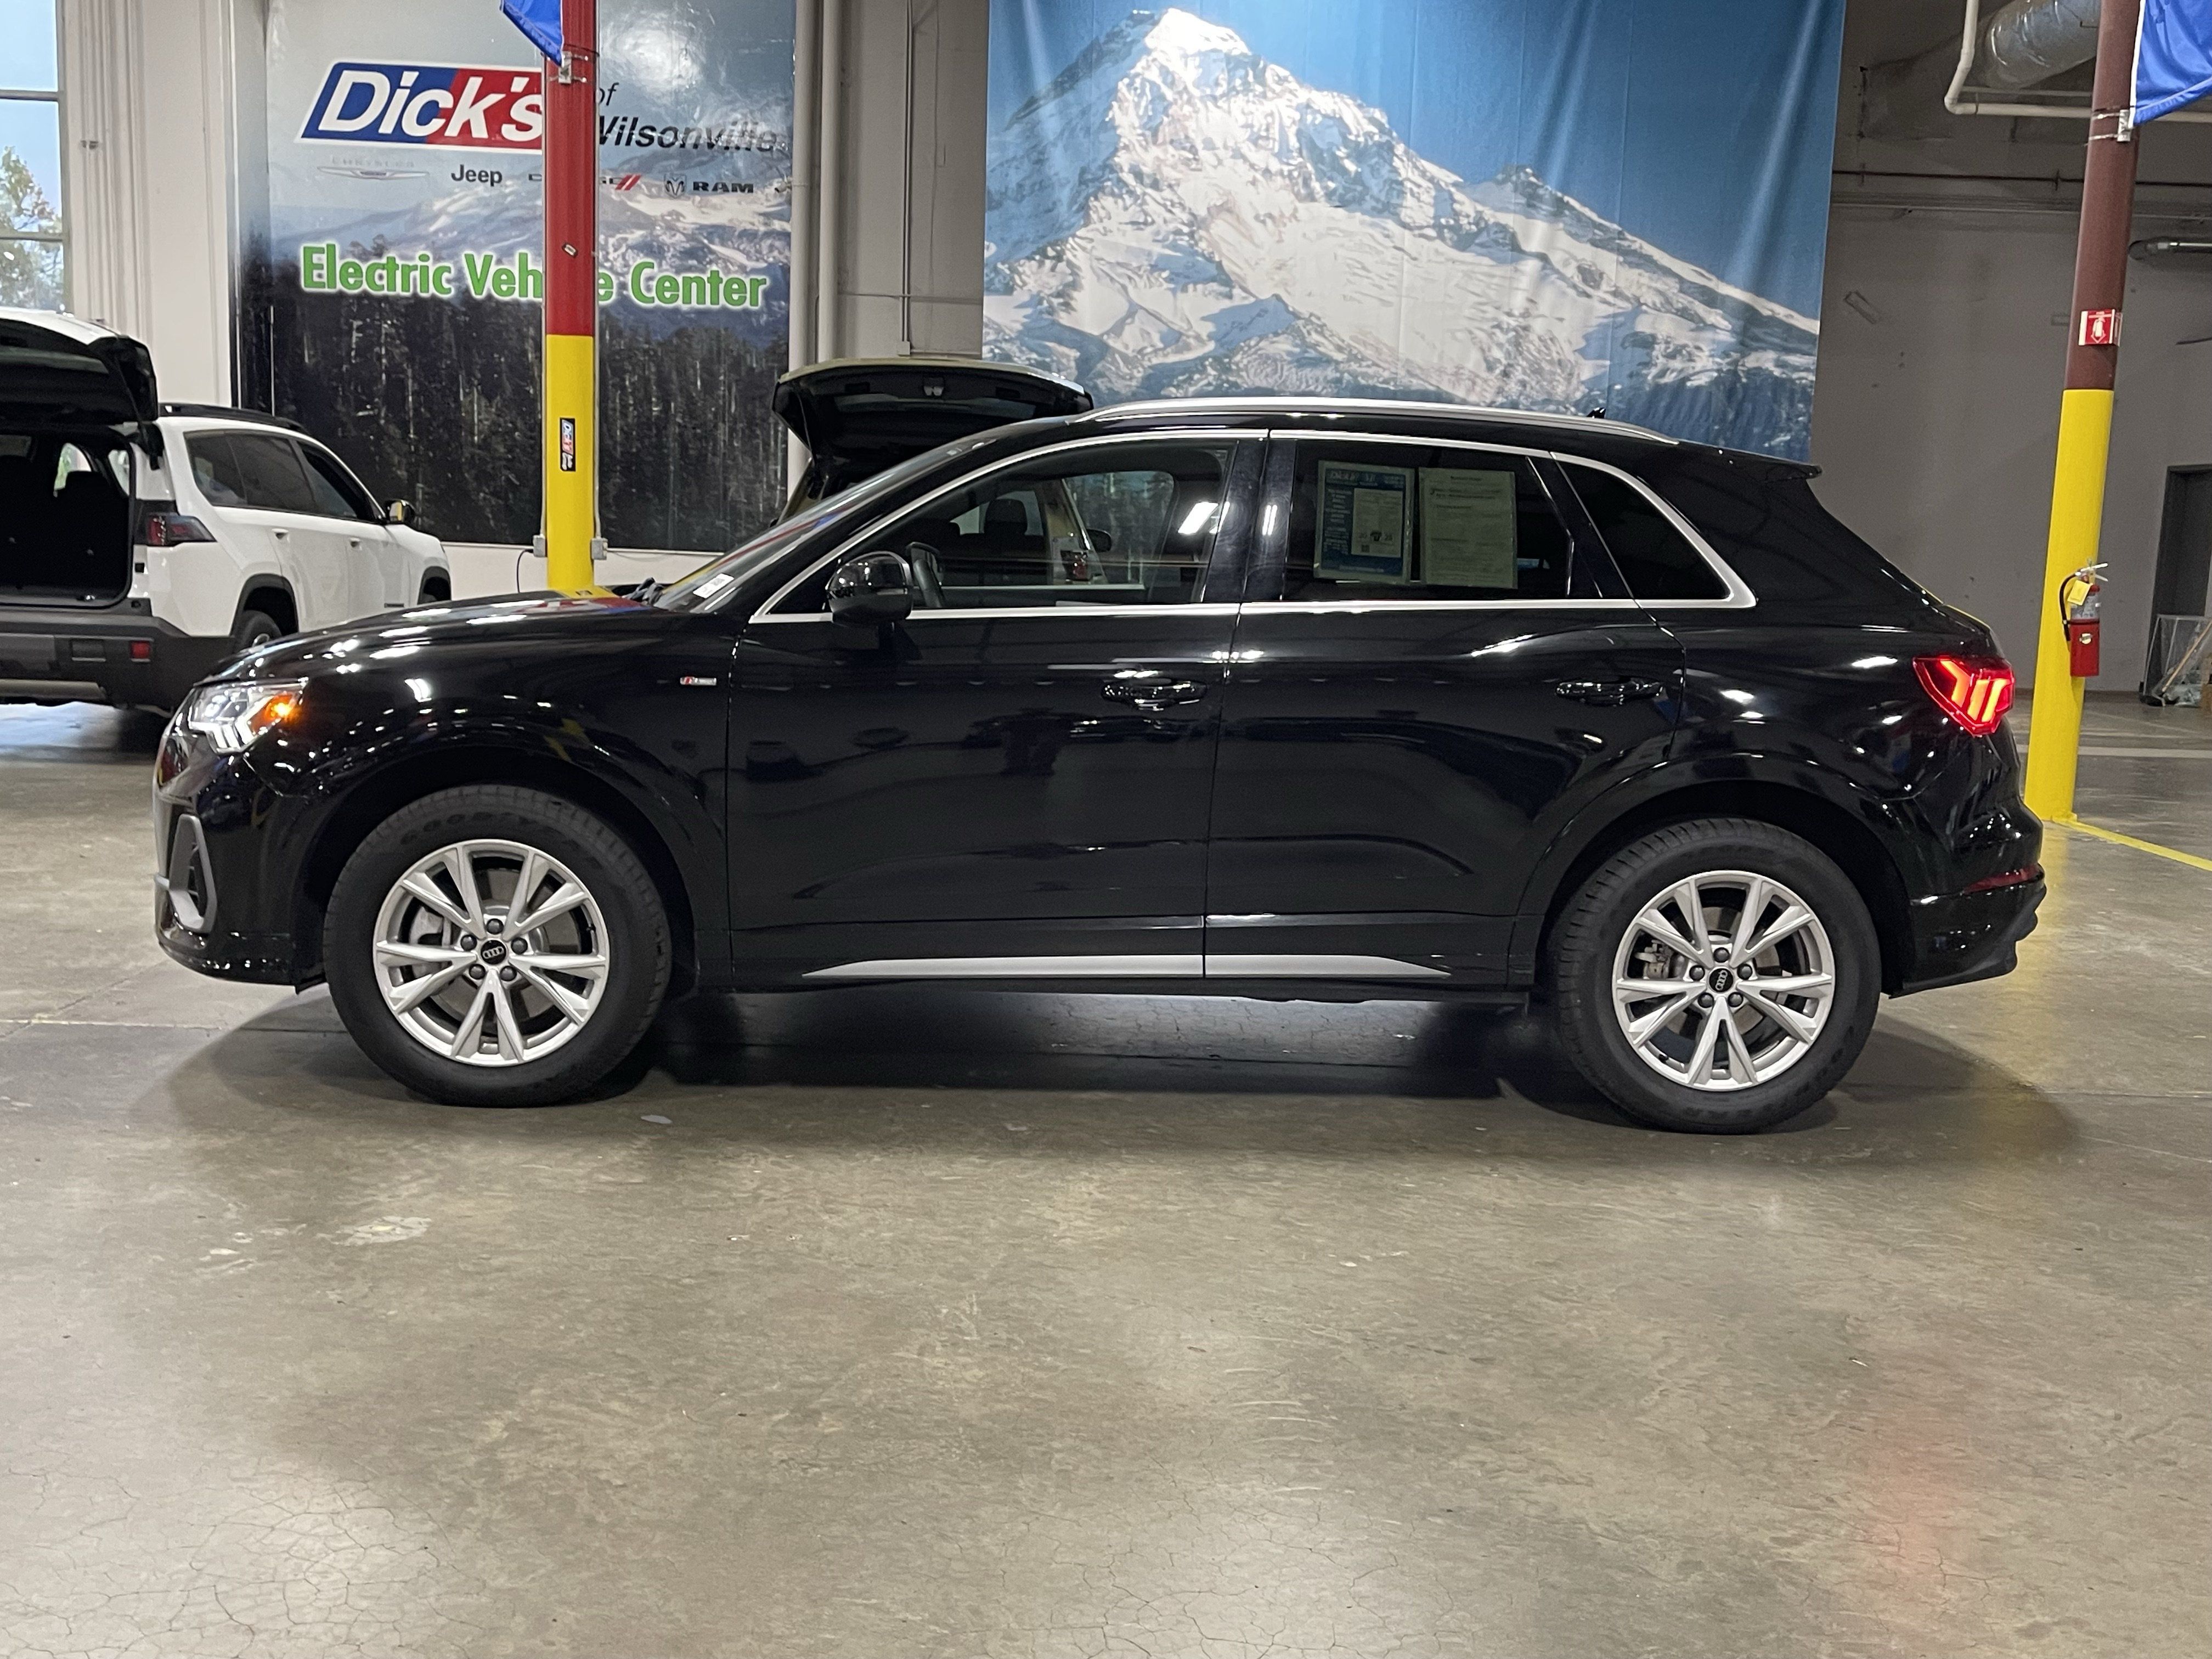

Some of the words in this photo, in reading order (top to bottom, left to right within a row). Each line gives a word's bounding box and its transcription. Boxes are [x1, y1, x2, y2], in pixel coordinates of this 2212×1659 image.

[318, 70, 542, 142] Dick's
[451, 164, 503, 187] Jeep
[693, 181, 754, 193] RAM
[303, 243, 453, 295] Electric
[464, 252, 614, 299] Vehe
[631, 261, 766, 307] Center
